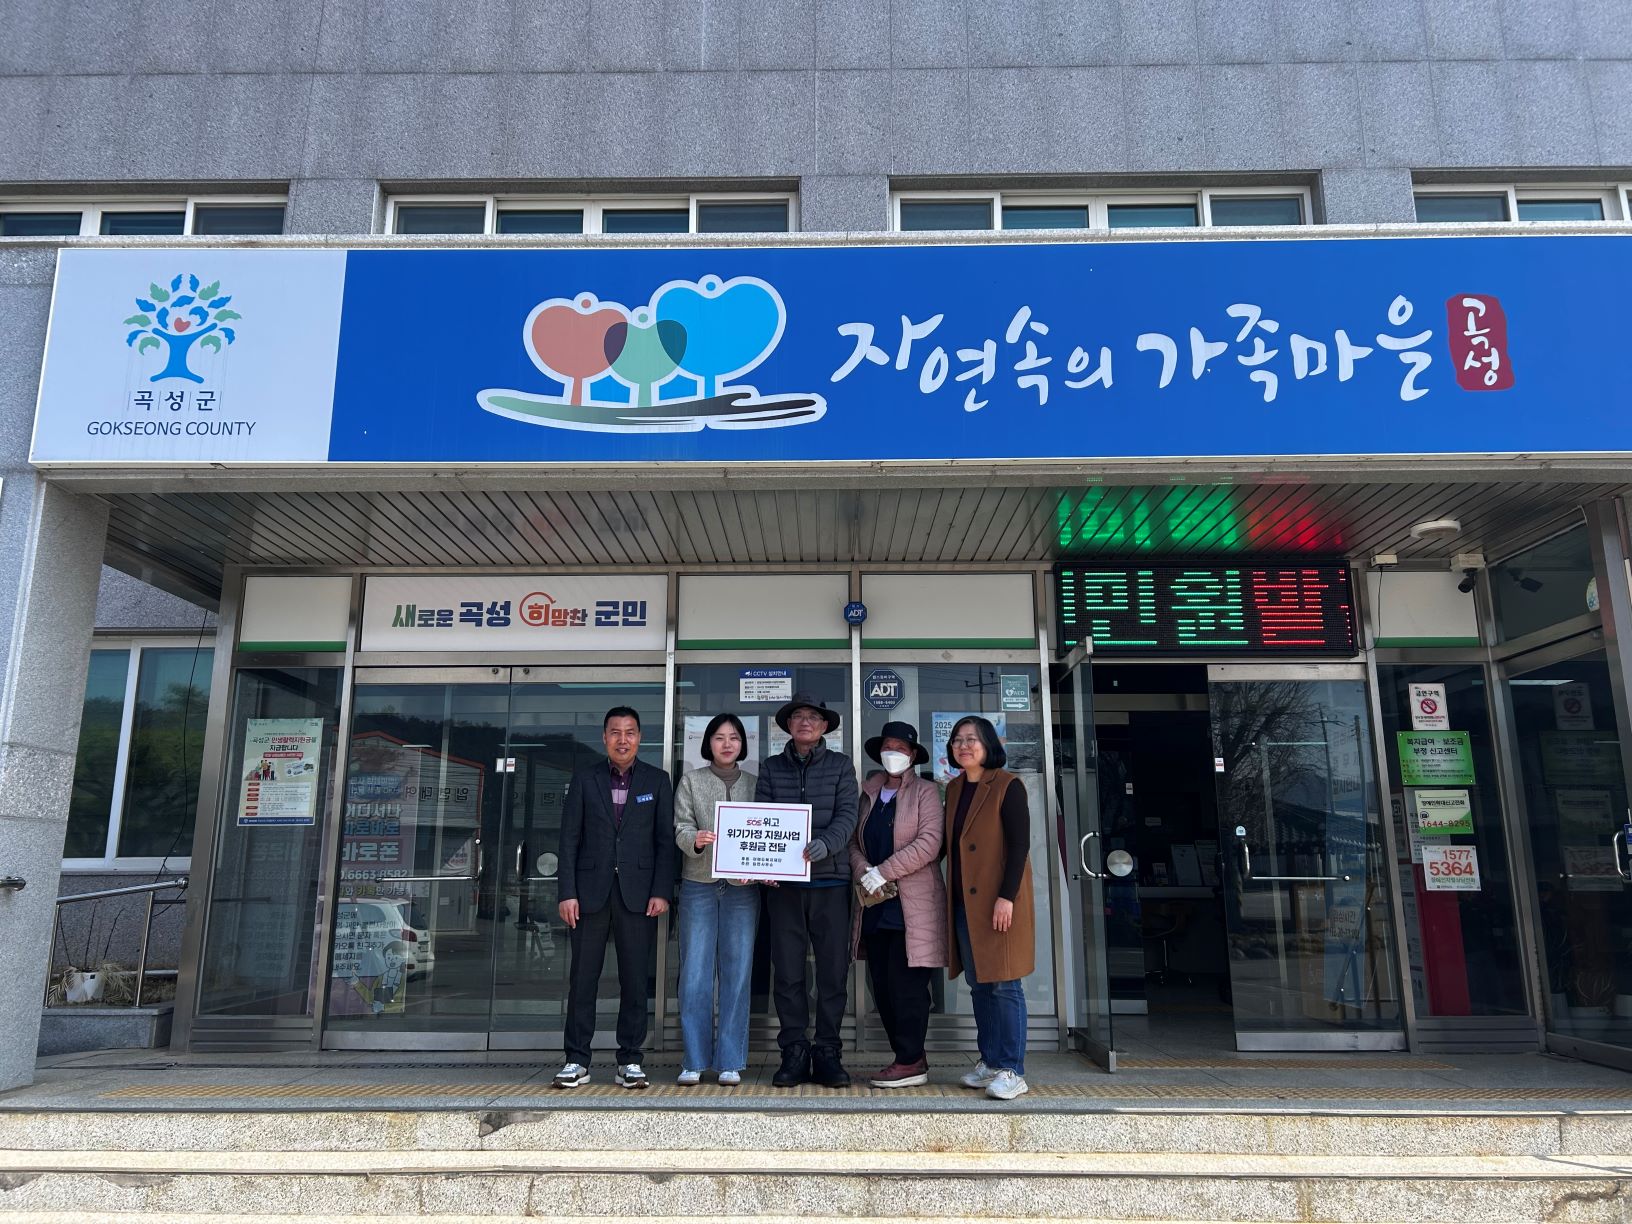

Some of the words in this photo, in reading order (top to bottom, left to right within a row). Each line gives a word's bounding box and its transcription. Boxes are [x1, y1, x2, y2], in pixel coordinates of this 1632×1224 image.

[1463, 297, 1500, 387] 곡성
[831, 305, 1113, 412] 자연속의
[1136, 294, 1433, 402] 가족마을
[134, 390, 216, 411] 곡성군
[87, 421, 182, 436] GOKSEONG
[185, 421, 257, 436] COUNTY
[391, 603, 454, 628] 새로운
[459, 600, 511, 627] 곡성
[519, 591, 588, 627] 희망찬
[595, 600, 647, 627] 군민
[848, 609, 863, 617] ADT
[870, 682, 898, 697] ADT
[934, 721, 952, 729] 2025
[1413, 747, 1427, 755] 부정
[1430, 747, 1458, 755] 신고센터
[1422, 820, 1471, 829] 1644-8295
[727, 828, 763, 840] 위기가정
[764, 830, 801, 841] 지원사업
[739, 841, 767, 852] 후원금
[768, 842, 787, 853] 전달
[1429, 861, 1475, 876] 5364
